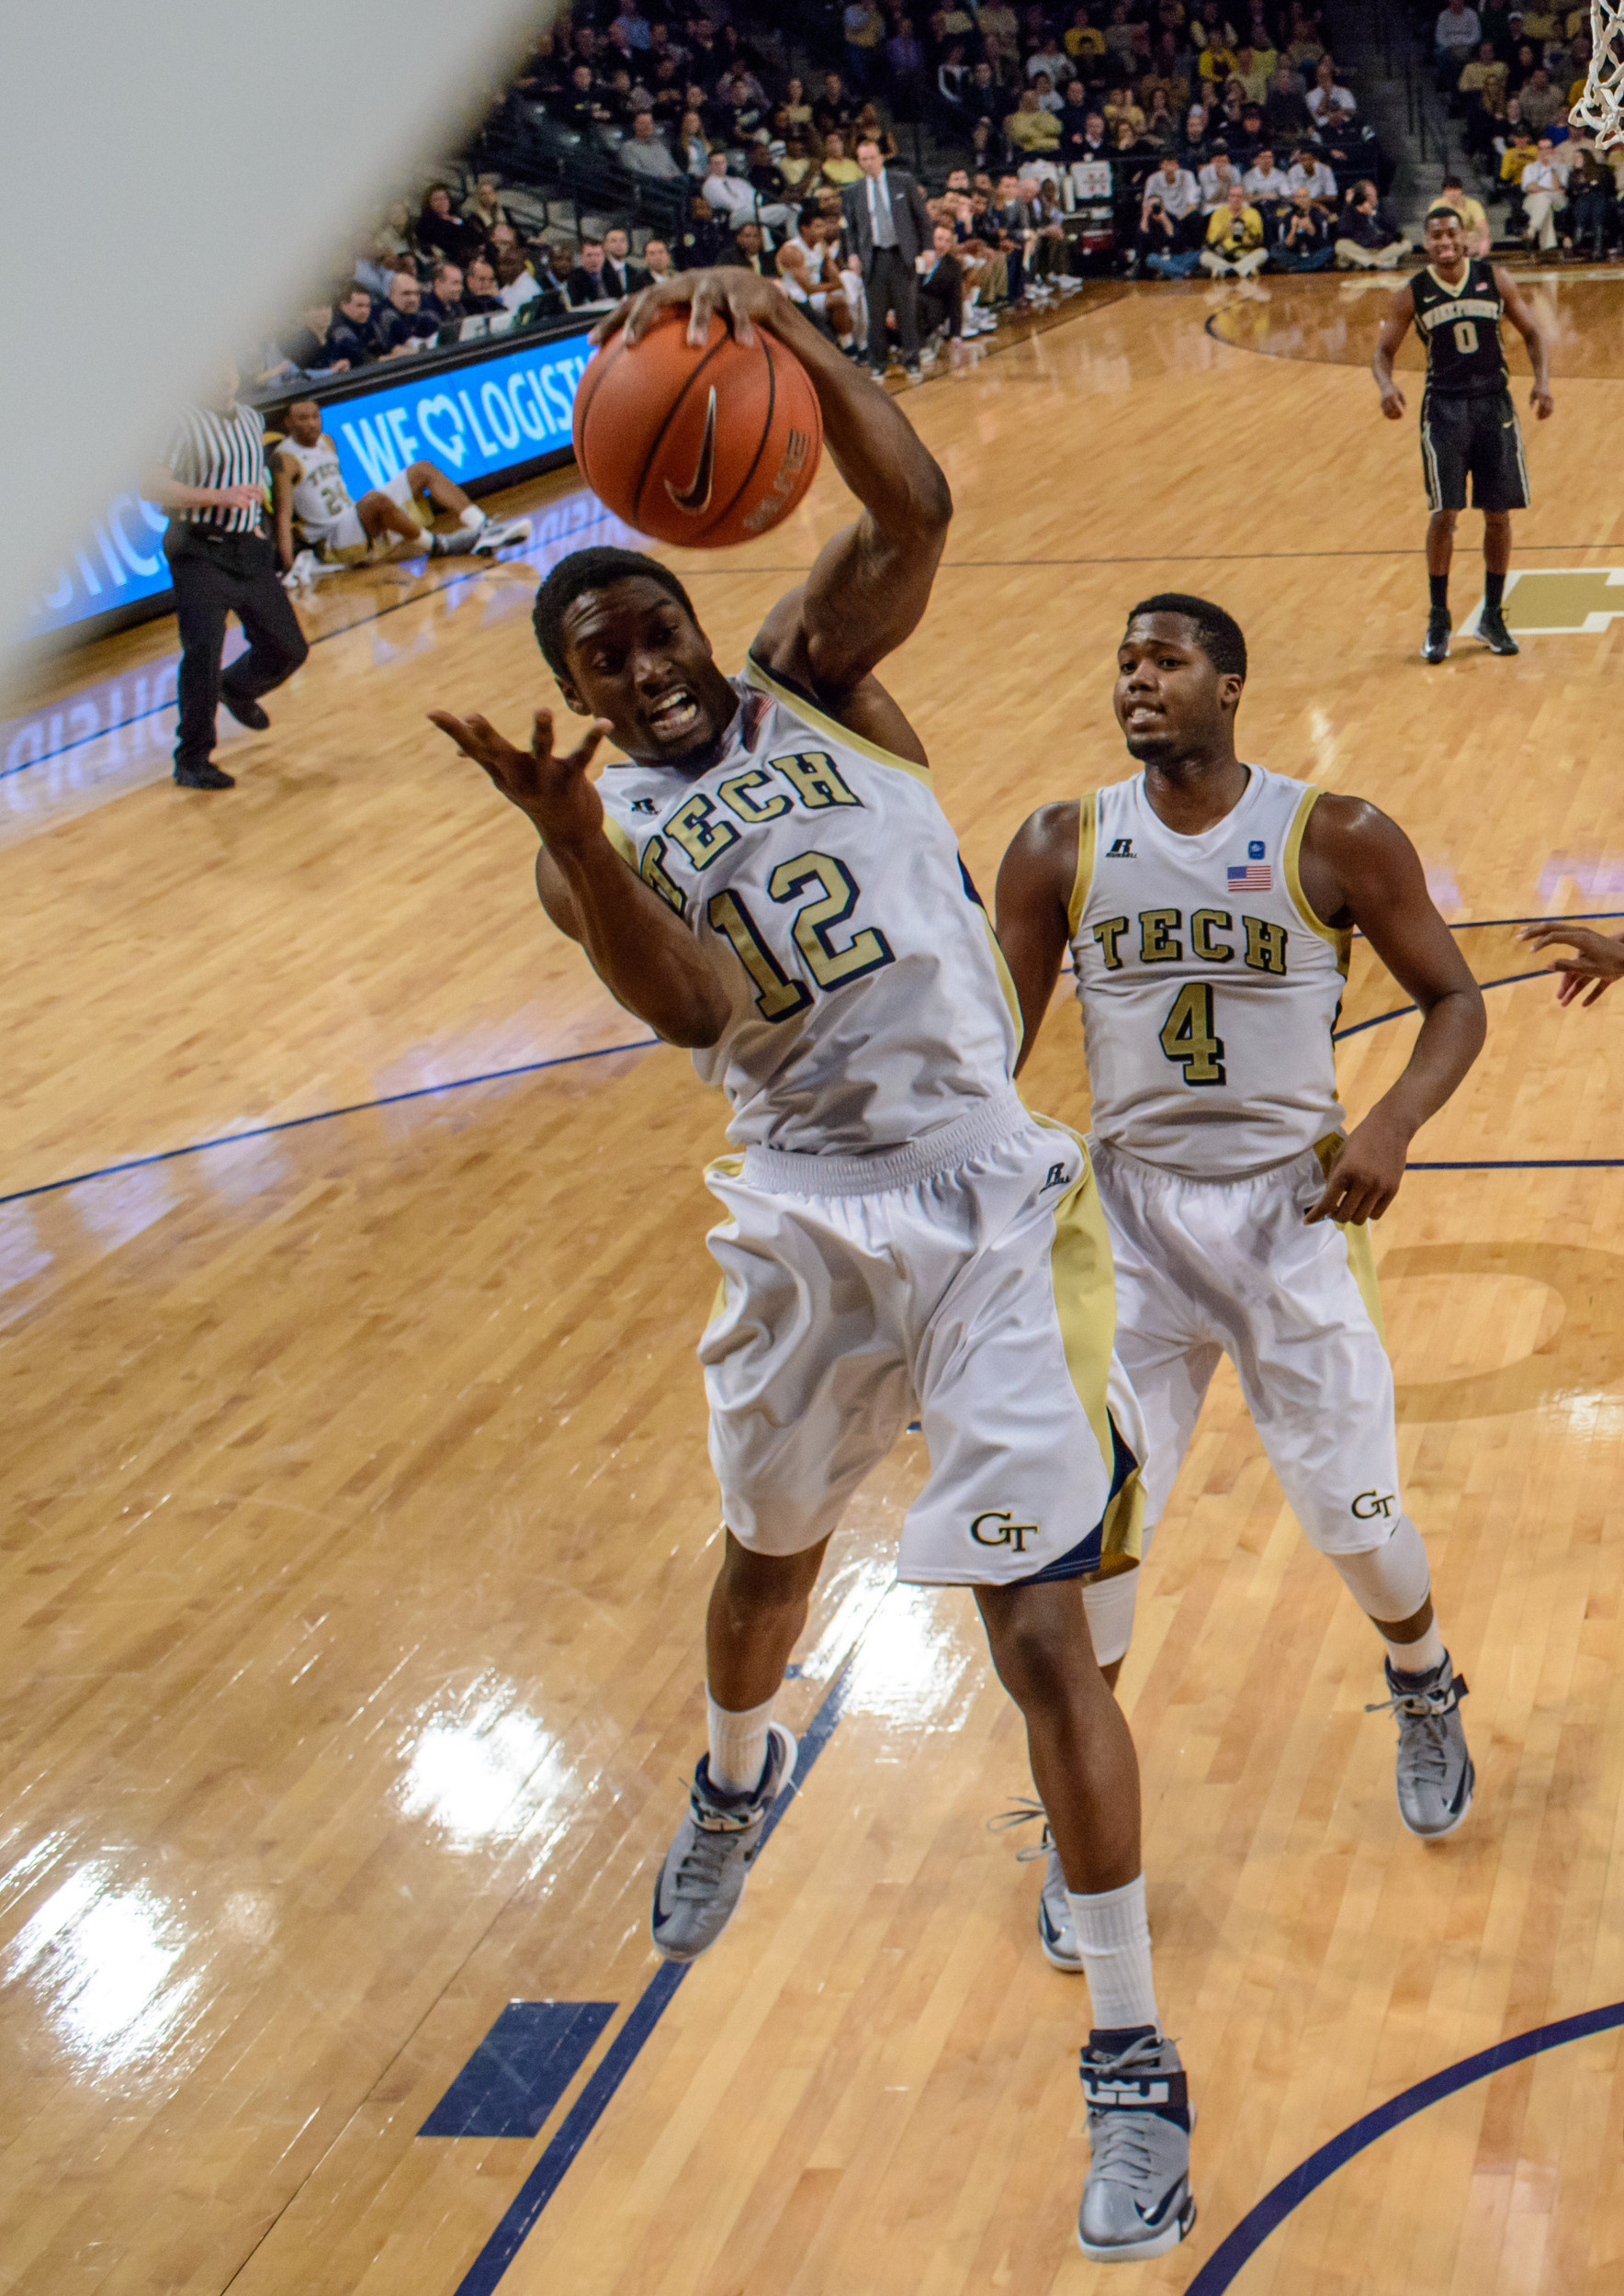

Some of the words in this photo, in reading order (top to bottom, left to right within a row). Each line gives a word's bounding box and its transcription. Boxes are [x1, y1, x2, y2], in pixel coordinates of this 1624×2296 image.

[1453, 321, 1479, 355] 0
[341, 407, 419, 490] WE
[457, 348, 600, 457] LOGIST
[707, 850, 897, 1023] 12
[1092, 908, 1288, 975] TECH
[1159, 982, 1226, 1086] 4
[970, 1510, 1039, 1553] GT
[1351, 1489, 1395, 1519] GT
